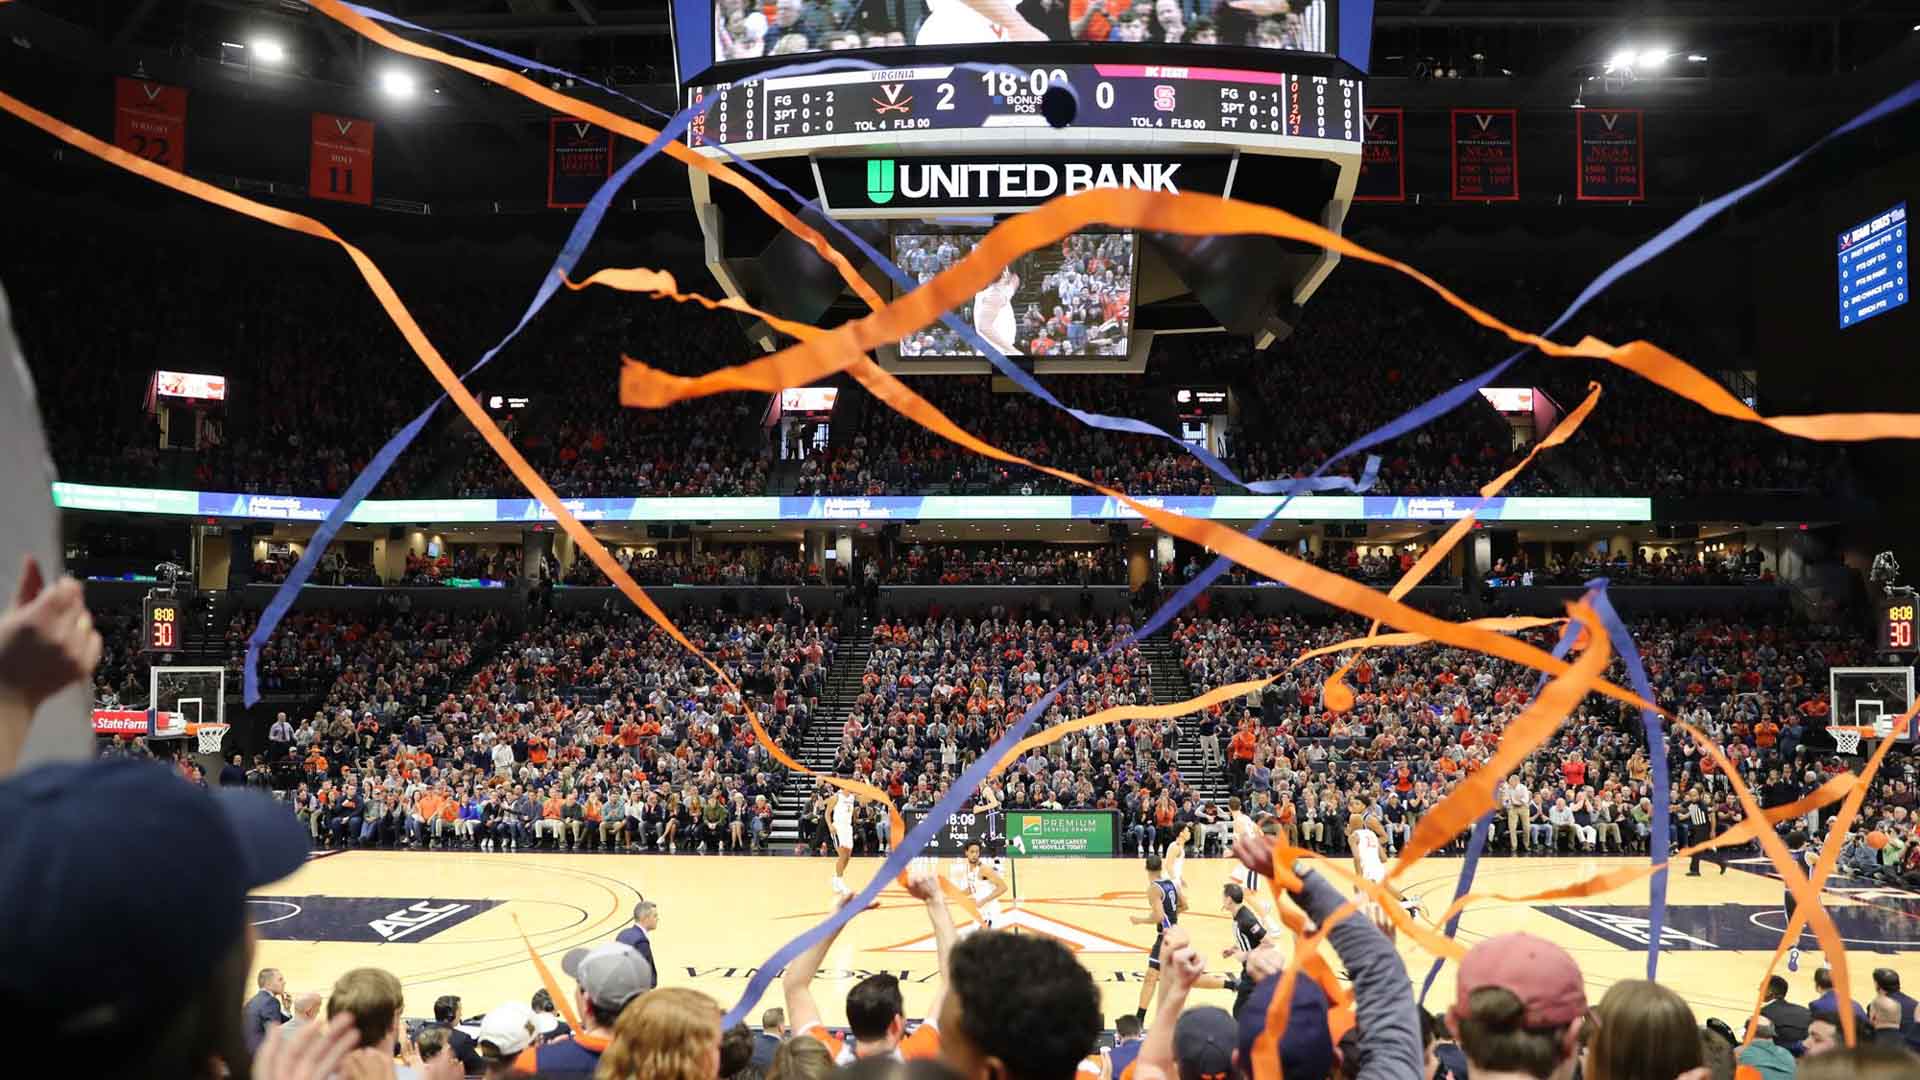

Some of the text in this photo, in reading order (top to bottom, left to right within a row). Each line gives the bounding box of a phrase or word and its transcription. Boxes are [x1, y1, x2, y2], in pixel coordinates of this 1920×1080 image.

[871, 70, 915, 81] VIRGINIA
[720, 92, 728, 101] 0
[747, 88, 754, 97] 0
[936, 83, 955, 110] 2
[1096, 82, 1114, 109] 0
[1221, 88, 1239, 99] FG
[1249, 91, 1257, 101] 0
[1291, 83, 1351, 97] 0 0 0
[720, 99, 754, 111] 0 0
[774, 95, 792, 107] FG
[802, 93, 810, 104] 0
[826, 91, 834, 102] 2
[1006, 96, 1043, 105] BONUS
[1317, 96, 1324, 105] 0
[1344, 98, 1351, 108] 0
[774, 109, 797, 120] 3PT
[802, 108, 810, 119] 0
[826, 106, 833, 117] 0
[1014, 104, 1036, 113] POS
[1221, 103, 1244, 114] 3PT
[1250, 105, 1257, 115] 0
[1271, 106, 1279, 117] 0
[1317, 107, 1324, 116] 0
[1344, 109, 1351, 119] 0
[720, 113, 727, 122] 0
[747, 110, 754, 119] 0
[1131, 117, 1163, 127] TOL 4
[1289, 115, 1351, 129] 21 0 0
[720, 123, 727, 132] 0
[746, 120, 754, 129] 0
[774, 124, 790, 135] FT
[802, 122, 810, 133] 0
[826, 120, 833, 131] 0
[855, 120, 886, 131] TOL 4
[894, 118, 930, 128] FLS 00
[1171, 119, 1206, 129] FLS 00
[1221, 117, 1238, 128] FT
[1250, 119, 1257, 129] 0
[1271, 120, 1279, 131] 0
[720, 133, 727, 143] 0
[746, 131, 753, 140] 0
[1318, 127, 1325, 137] 0
[1345, 130, 1352, 139] 0
[900, 163, 1182, 198] UNITED BANK
[153, 608, 175, 622] 18:08
[1889, 606, 1913, 620] 18:08
[154, 623, 172, 646] 30
[1890, 622, 1911, 646] 30
[1043, 819, 1096, 827] PREMIUM
[368, 901, 461, 938] ACC
